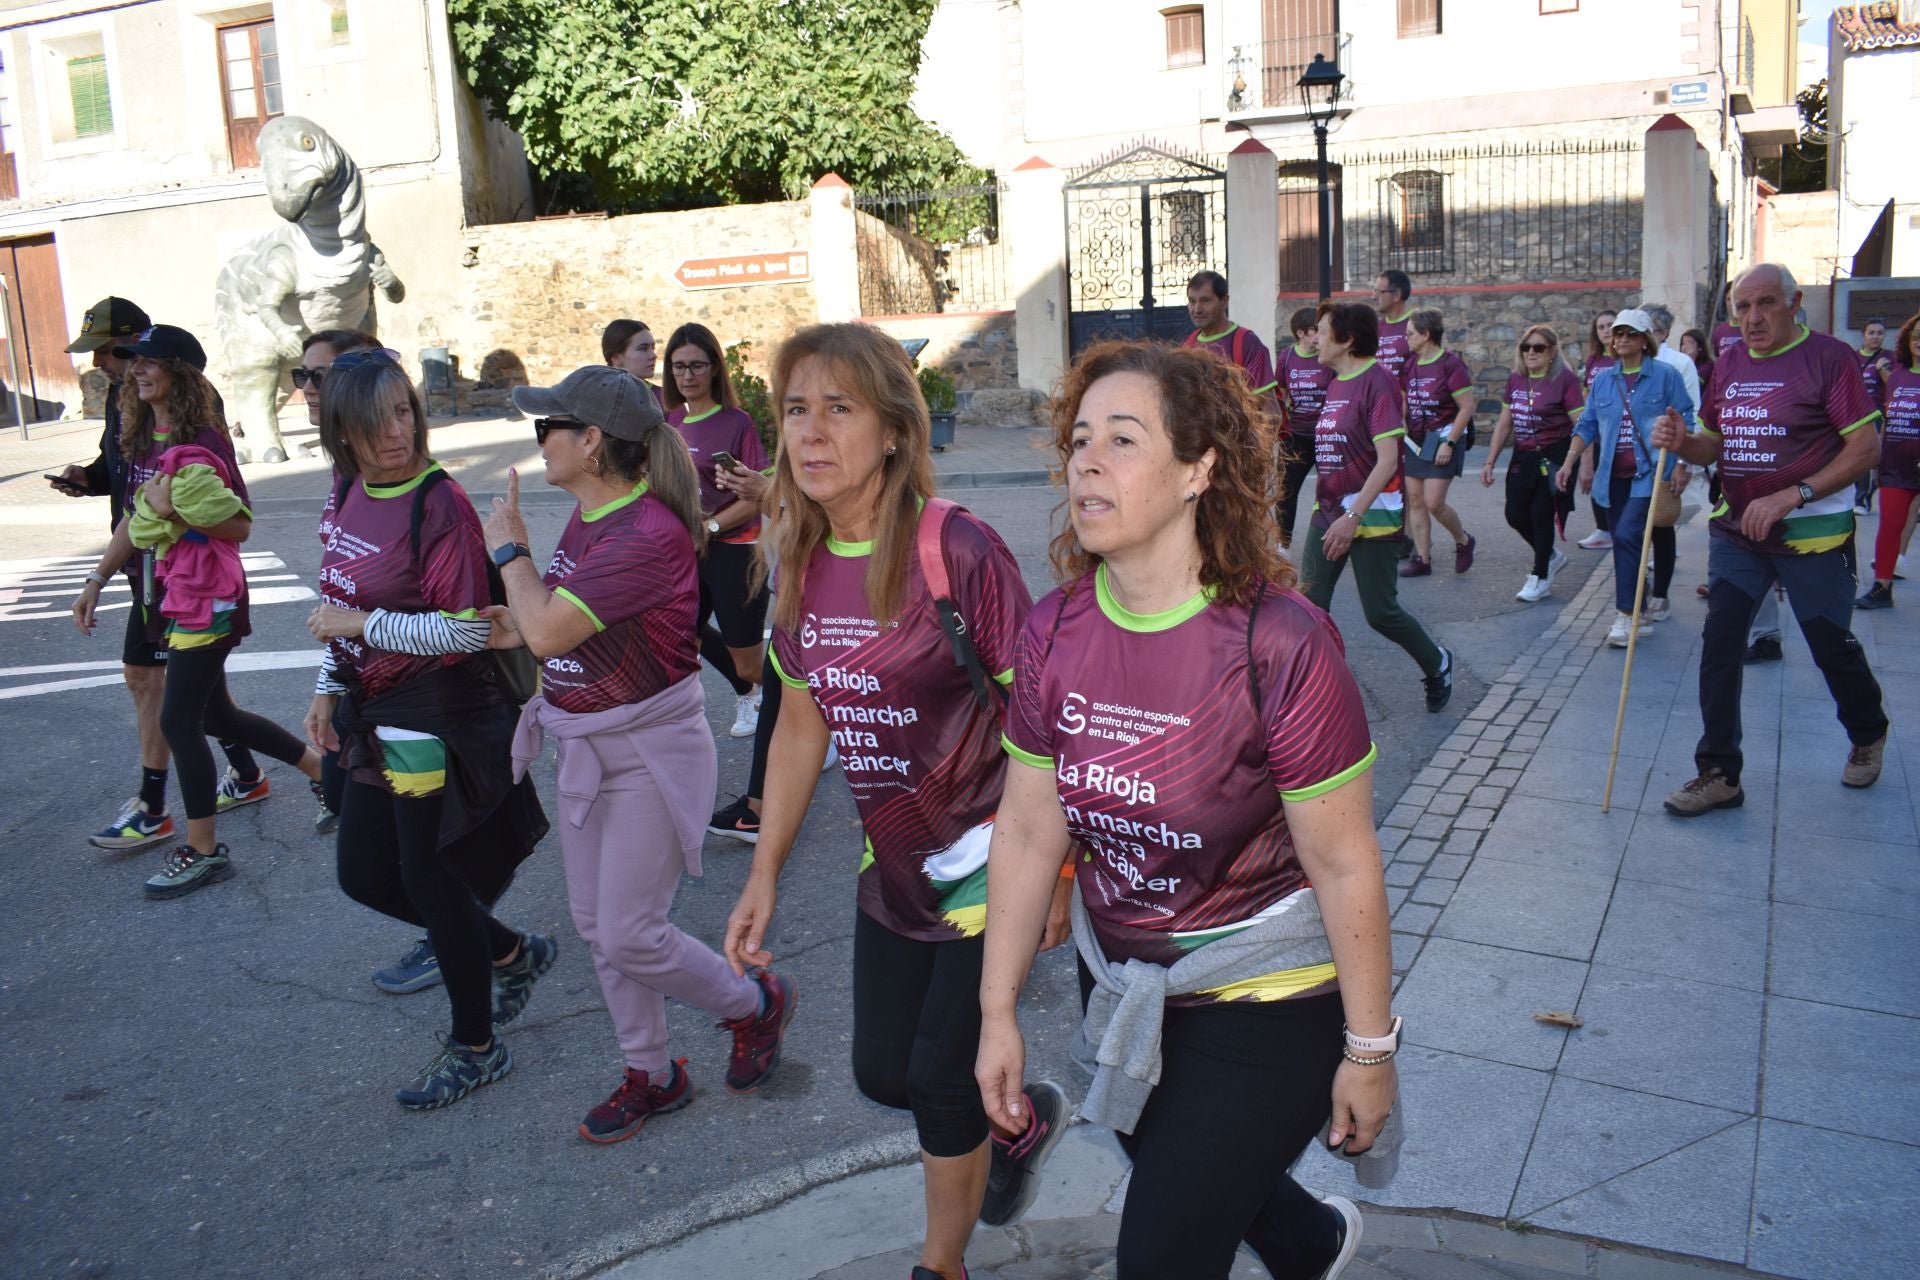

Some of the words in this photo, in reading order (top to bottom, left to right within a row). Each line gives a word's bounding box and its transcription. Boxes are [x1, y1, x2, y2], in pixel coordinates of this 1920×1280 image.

[747, 263, 760, 274] de
[1721, 407, 1733, 419] La
[1736, 406, 1768, 421] Rioja
[1899, 400, 1917, 410] Rioja
[1721, 423, 1733, 436] En
[1735, 423, 1787, 436] marcha
[1731, 450, 1776, 462] cáncer
[330, 568, 356, 595] Rioja
[821, 616, 860, 626] asociación
[821, 628, 844, 636] contra
[847, 627, 853, 635] el
[854, 628, 879, 638] cáncer
[832, 637, 841, 645] La
[843, 637, 861, 649] Rioja
[827, 667, 881, 695] Rioja
[833, 705, 918, 727] marcha
[1093, 701, 1143, 717] asociación
[1144, 710, 1190, 726] española
[1091, 715, 1121, 729] contra
[1123, 720, 1132, 729] el
[1134, 722, 1166, 735] cáncer
[1089, 728, 1101, 737] en
[1102, 728, 1115, 740] La
[1116, 731, 1140, 745] Rioja
[840, 750, 911, 776] cáncer
[1058, 754, 1079, 787] La
[1086, 764, 1155, 805] Rioja
[1089, 810, 1202, 849] marcha
[1107, 851, 1180, 894] cáncer
[1153, 904, 1175, 917] CÁNCER
